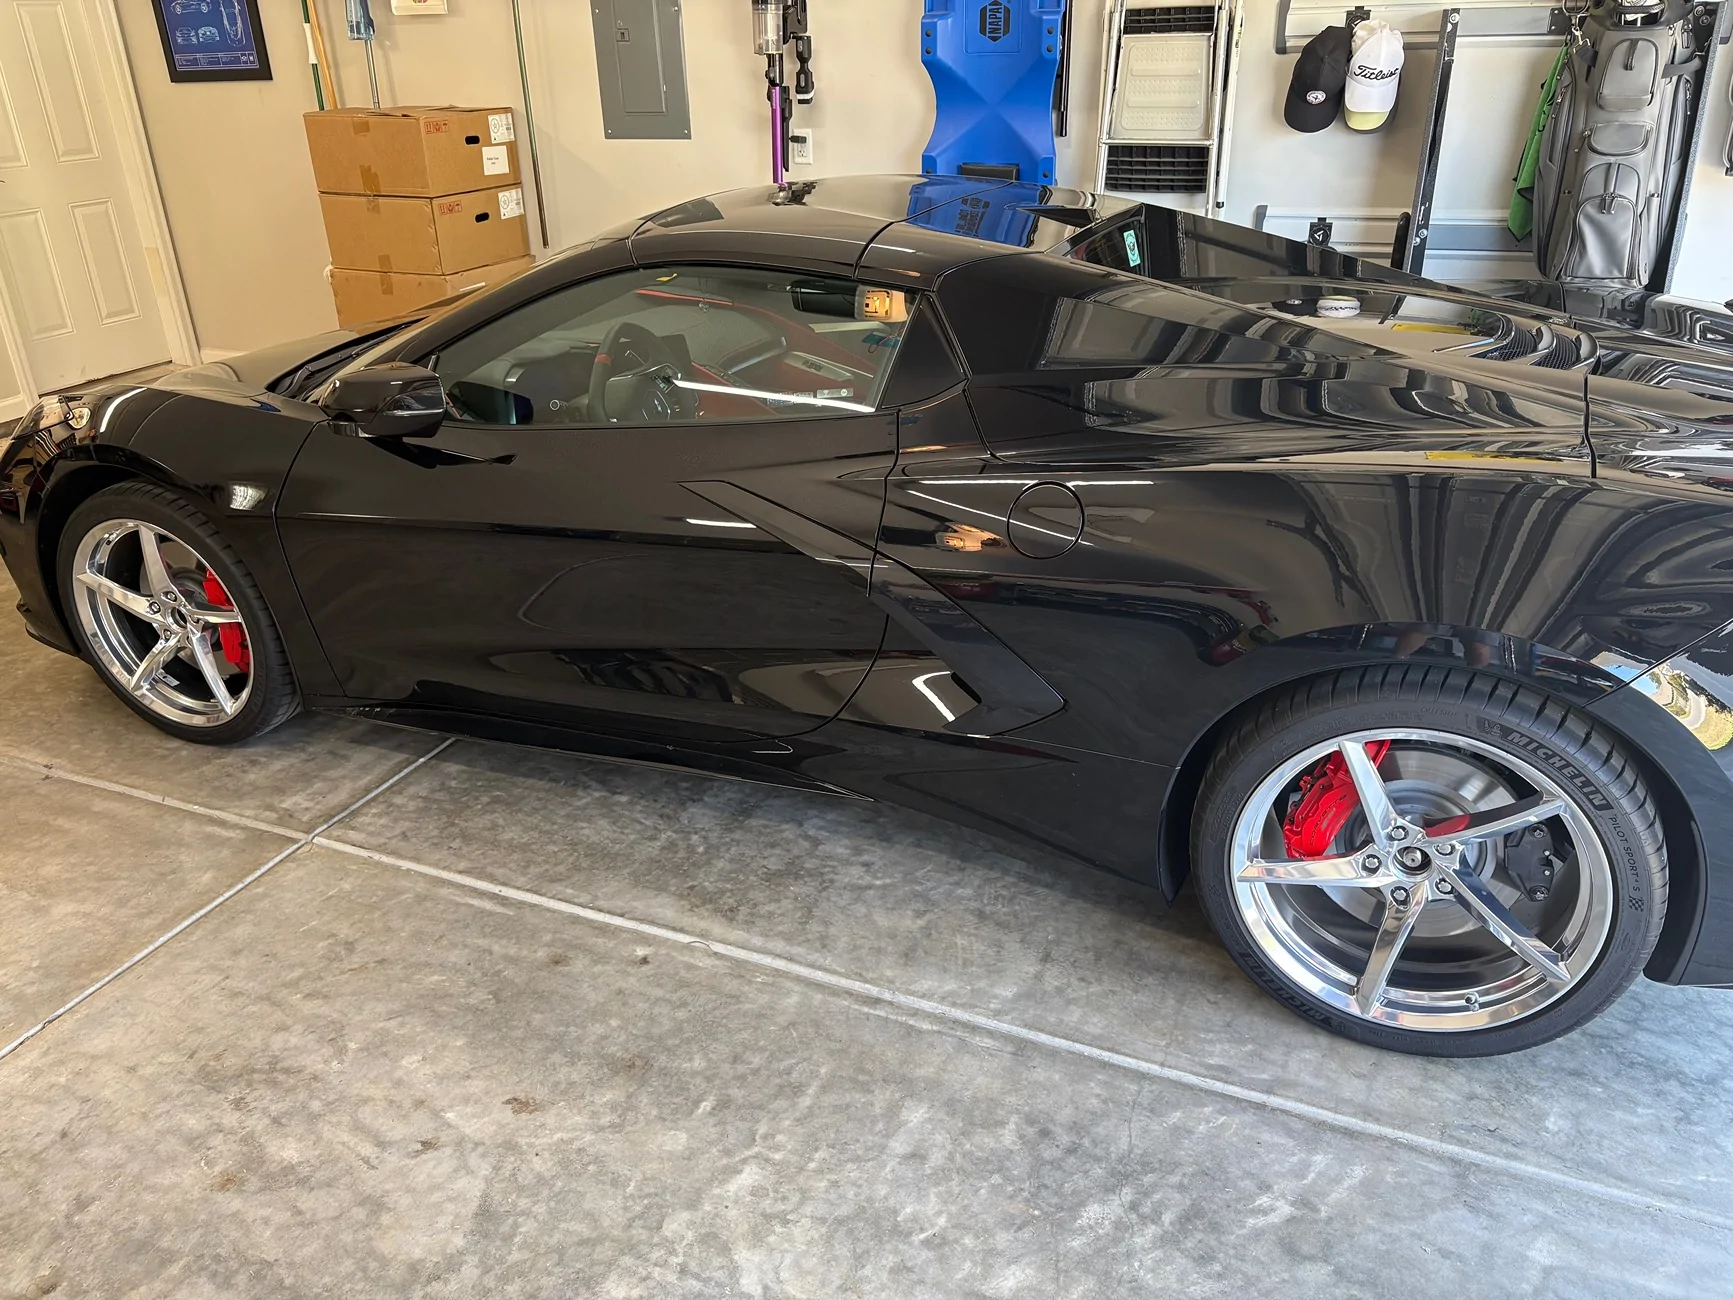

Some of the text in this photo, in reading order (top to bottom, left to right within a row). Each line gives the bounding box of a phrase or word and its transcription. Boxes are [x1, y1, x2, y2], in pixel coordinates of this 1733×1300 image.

[988, 7, 1003, 35] NAPA
[1353, 64, 1400, 81] Titleist
[1506, 733, 1607, 810] MICHELIN
[1309, 794, 1348, 847] CORVETTE
[1608, 817, 1629, 844] PILOT
[1623, 846, 1639, 877] SPORT
